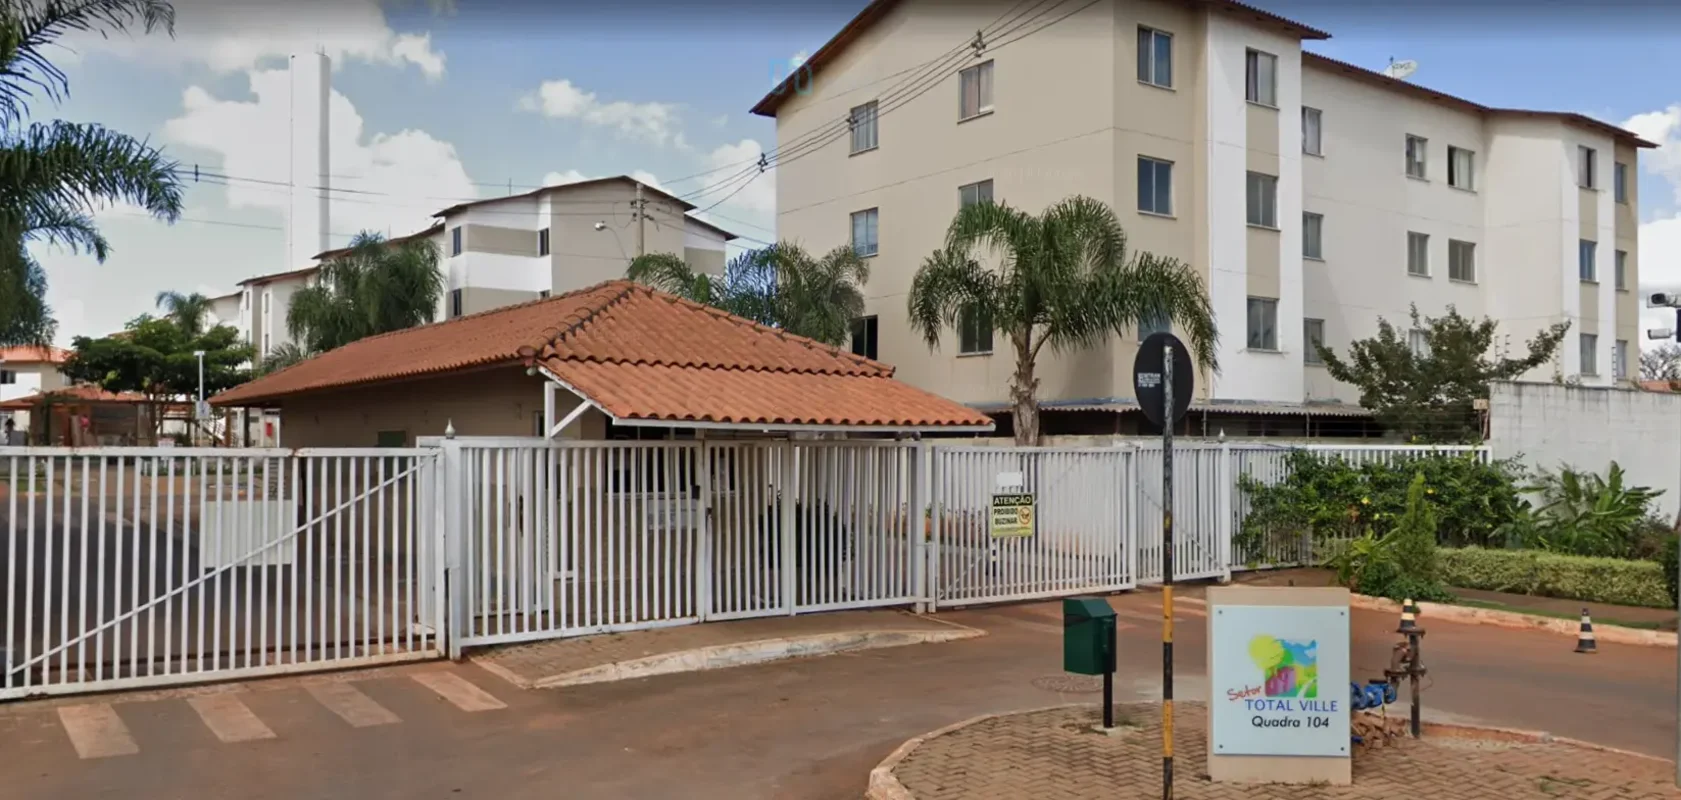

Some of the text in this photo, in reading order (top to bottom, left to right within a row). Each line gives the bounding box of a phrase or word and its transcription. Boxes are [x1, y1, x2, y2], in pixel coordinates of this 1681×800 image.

[994, 495, 1031, 505] ATENÇÃO
[1226, 685, 1262, 701] Setor
[1244, 699, 1338, 712] TOTAL VILLE
[1251, 715, 1329, 728] Quadra 104
